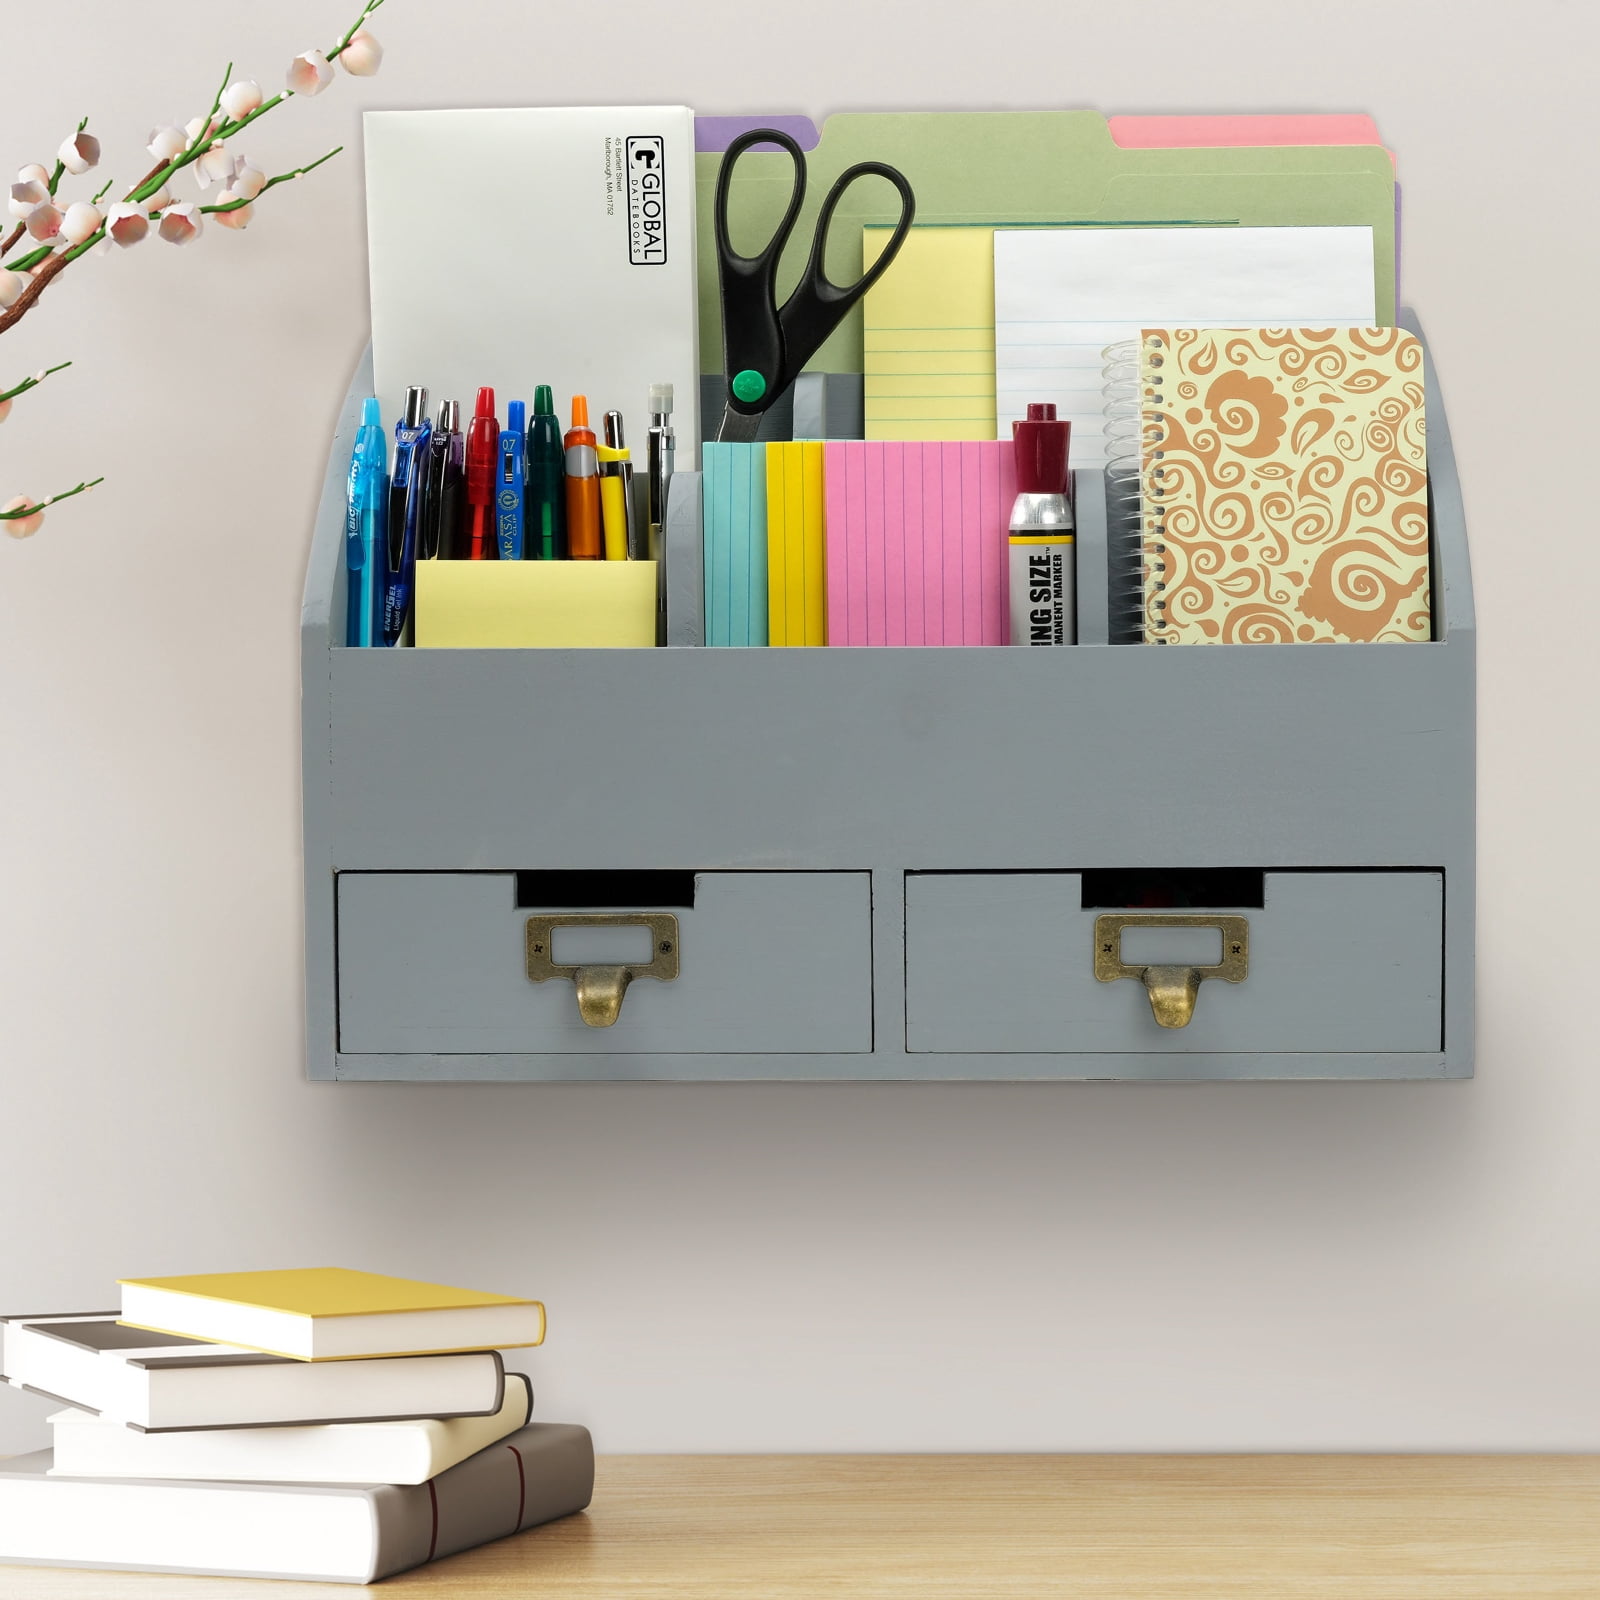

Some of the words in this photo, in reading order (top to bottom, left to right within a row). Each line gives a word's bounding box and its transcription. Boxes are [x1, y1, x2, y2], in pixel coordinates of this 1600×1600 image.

[614, 137, 622, 146] 45
[606, 182, 613, 194] MA
[615, 173, 623, 192] Street
[631, 179, 641, 254] DATEBOOKS
[641, 173, 662, 260] GLOBAL
[1053, 554, 1063, 599] MARKER
[1053, 601, 1063, 646] MANENT
